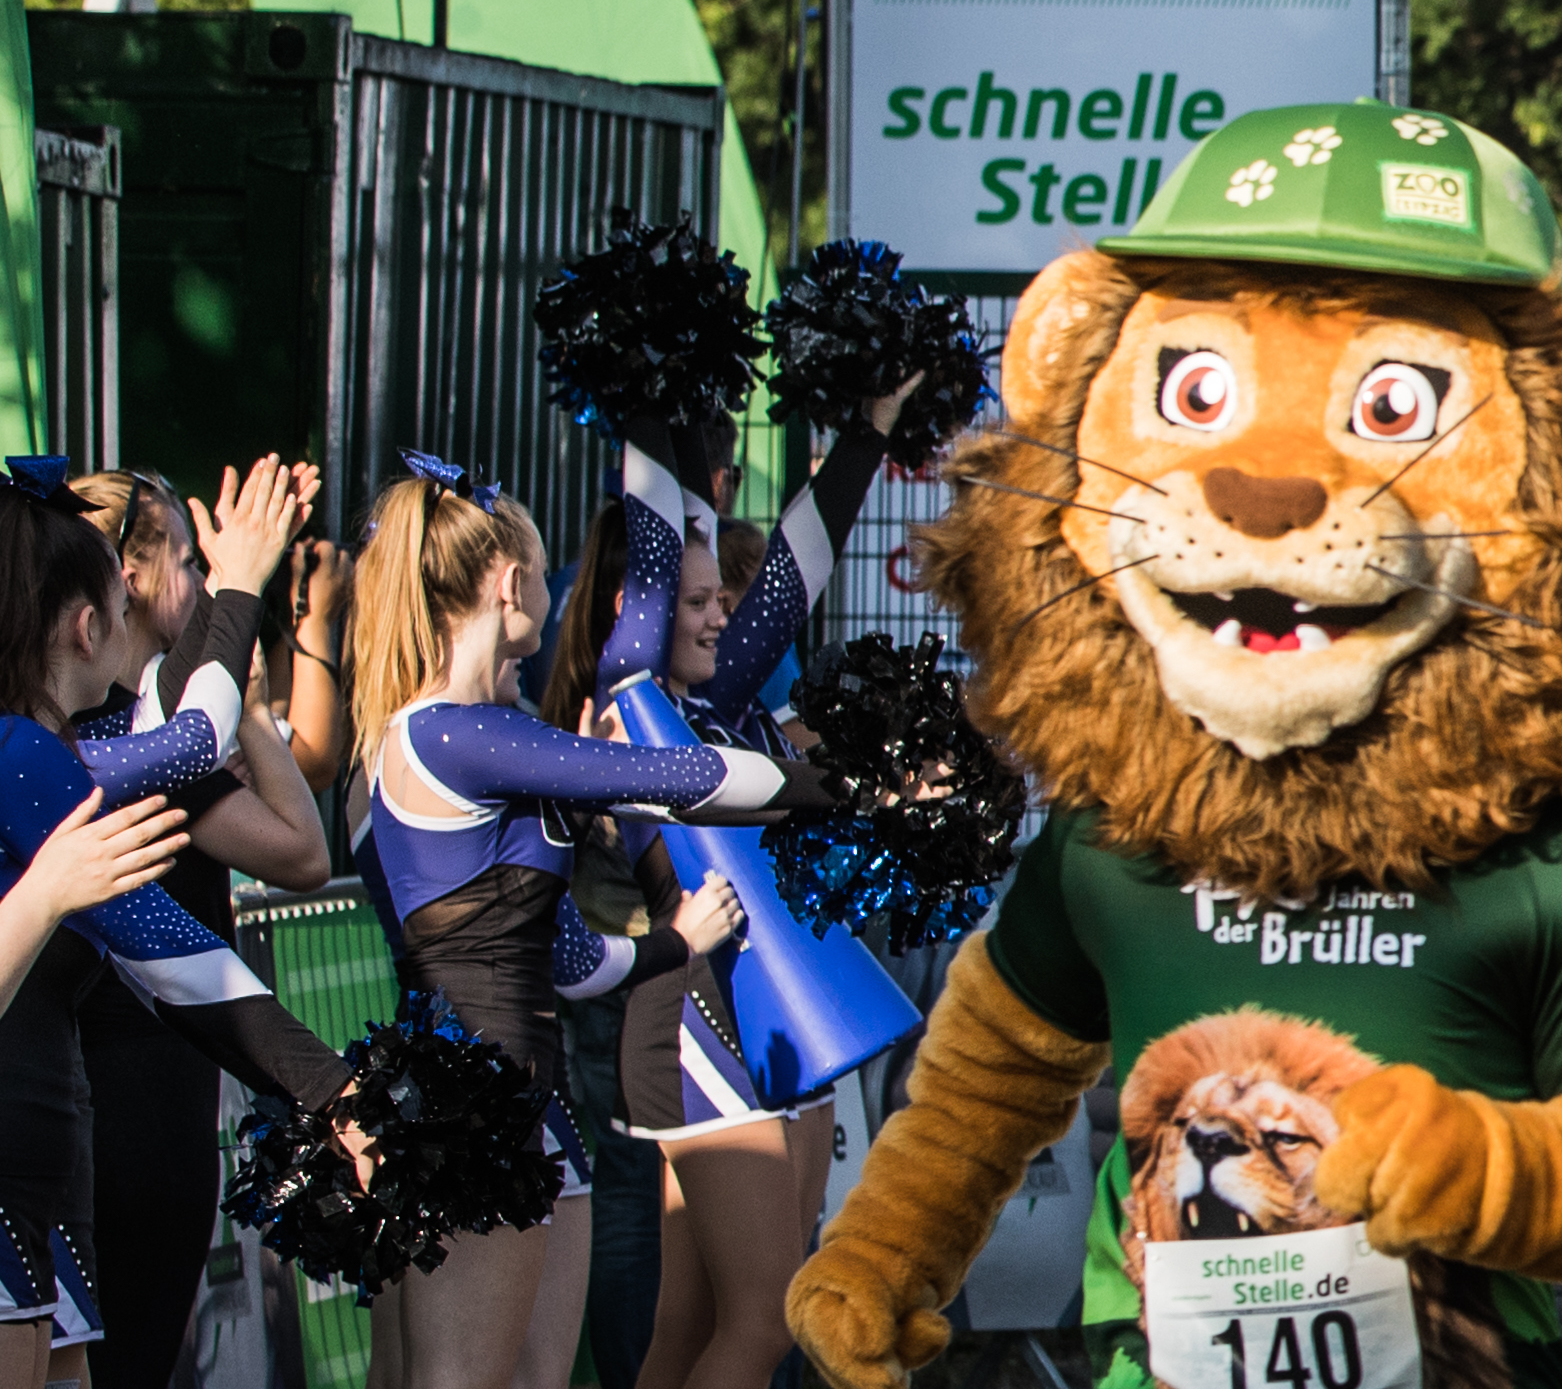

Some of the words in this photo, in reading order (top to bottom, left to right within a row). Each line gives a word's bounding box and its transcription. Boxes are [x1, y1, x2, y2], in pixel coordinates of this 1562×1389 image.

[881, 70, 1226, 142] schnelle
[1213, 915, 1259, 944] der
[1260, 911, 1427, 968] Brüller
[1201, 1250, 1305, 1279] schnelle
[1233, 1273, 1350, 1305] Stelle.de
